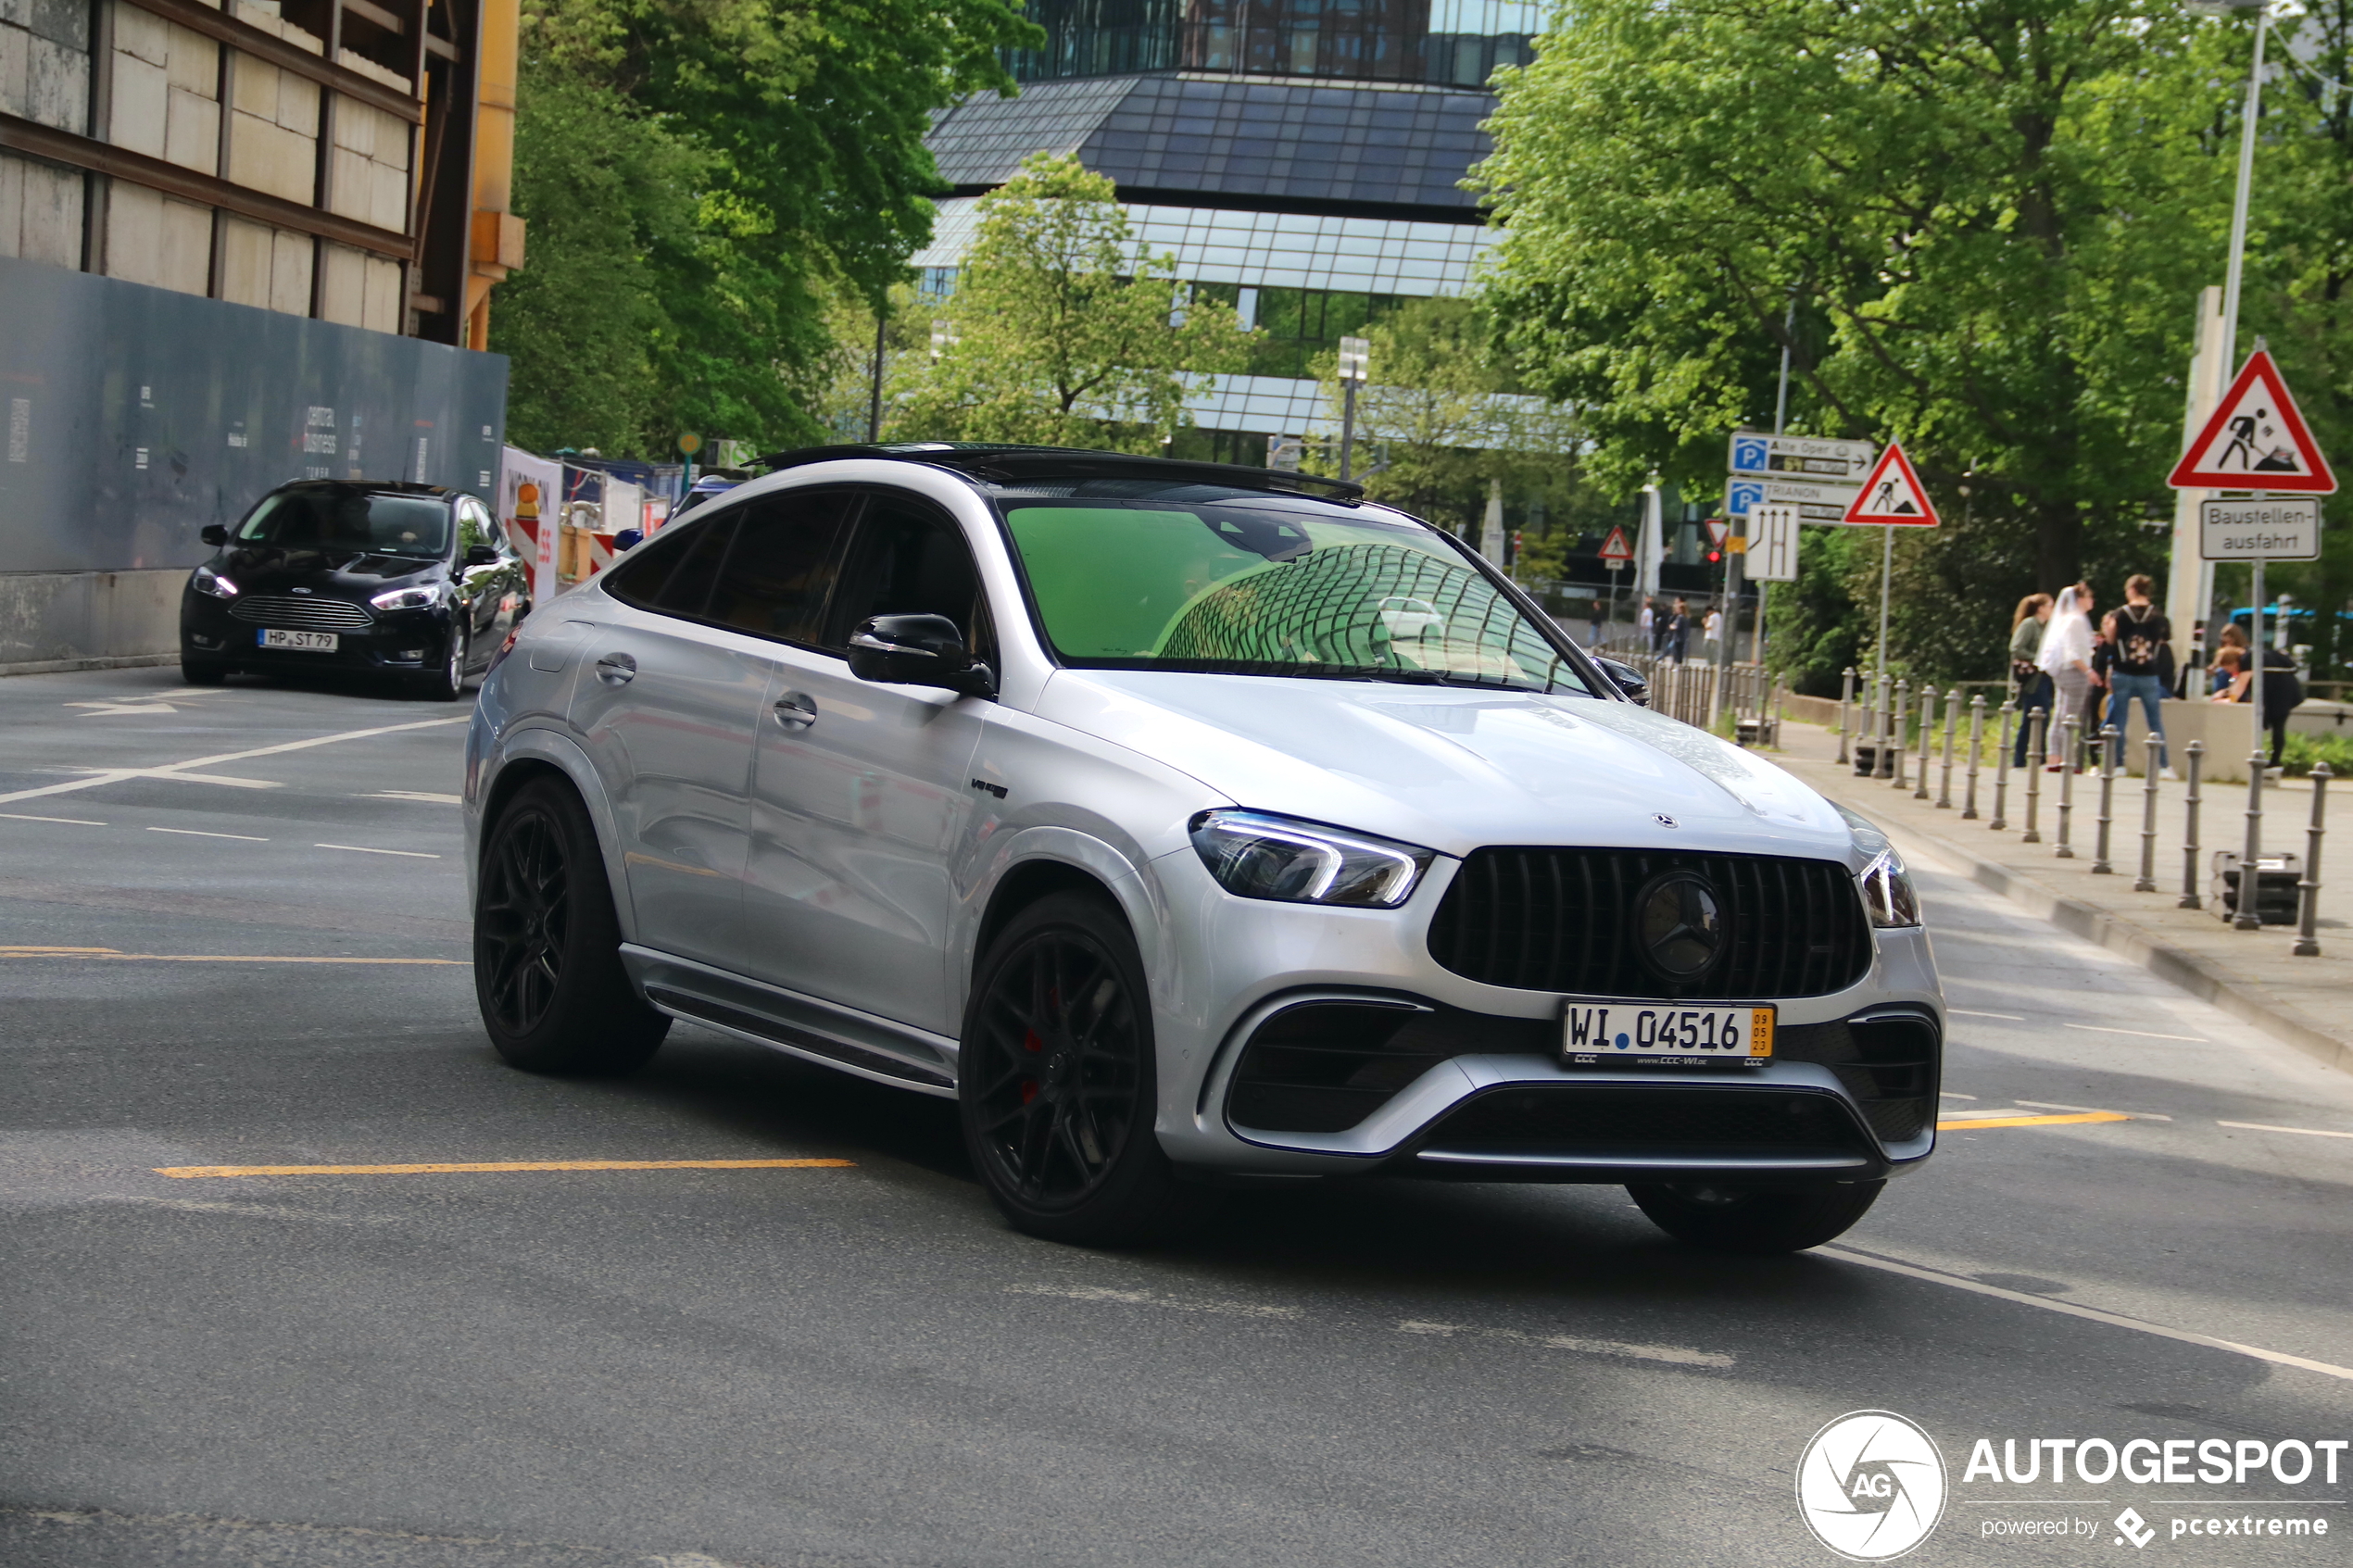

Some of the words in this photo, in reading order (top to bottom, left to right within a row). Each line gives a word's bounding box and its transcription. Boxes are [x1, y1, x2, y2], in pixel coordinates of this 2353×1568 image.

[1770, 440, 1796, 452] Alte
[1801, 443, 1831, 455] Oper
[1766, 484, 1821, 499] TRIANON
[2209, 508, 2314, 525] Baustellen-
[2223, 533, 2298, 550] ausfahrt
[269, 632, 286, 645] HP
[296, 633, 312, 646] ST
[316, 635, 332, 646] 79
[1754, 1014, 1767, 1024] 09
[1571, 1008, 1609, 1046] WI
[1636, 1010, 1739, 1049] 04516
[1753, 1027, 1767, 1037] 05
[1753, 1041, 1767, 1050] 23
